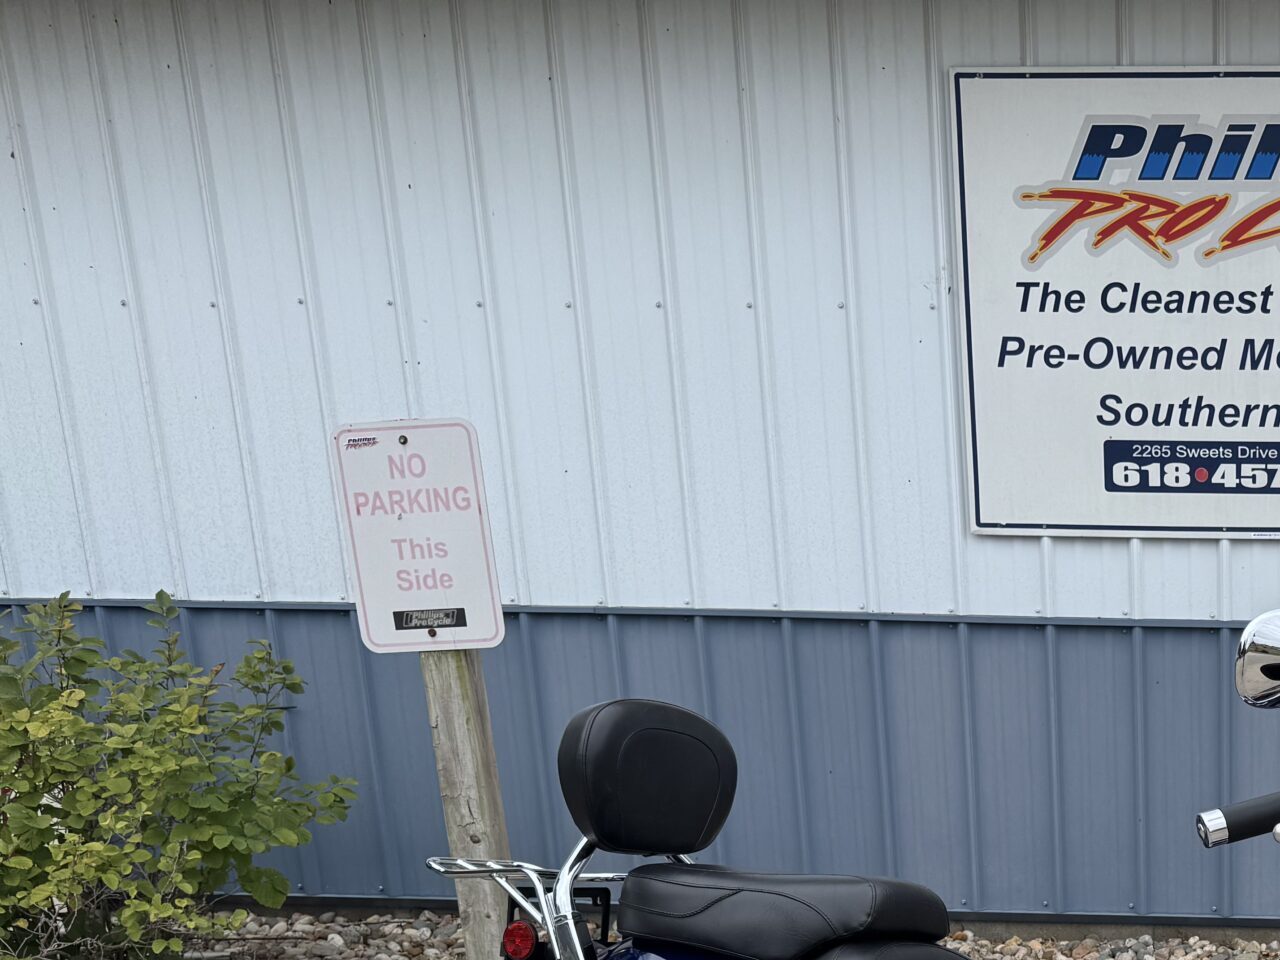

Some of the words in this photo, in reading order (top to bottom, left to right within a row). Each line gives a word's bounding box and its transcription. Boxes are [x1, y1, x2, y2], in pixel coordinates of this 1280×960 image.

[1020, 187, 1230, 264] PRO
[1014, 281, 1086, 314] The
[1098, 281, 1275, 315] Cleanest
[997, 335, 1228, 372] Pre-Owned
[1131, 444, 1172, 459] 2265
[1175, 444, 1233, 460] Sweets
[1237, 445, 1279, 460] Drive
[387, 453, 427, 480] NO
[353, 486, 472, 516] PARKING
[390, 536, 449, 561] This
[395, 567, 454, 592] Side
